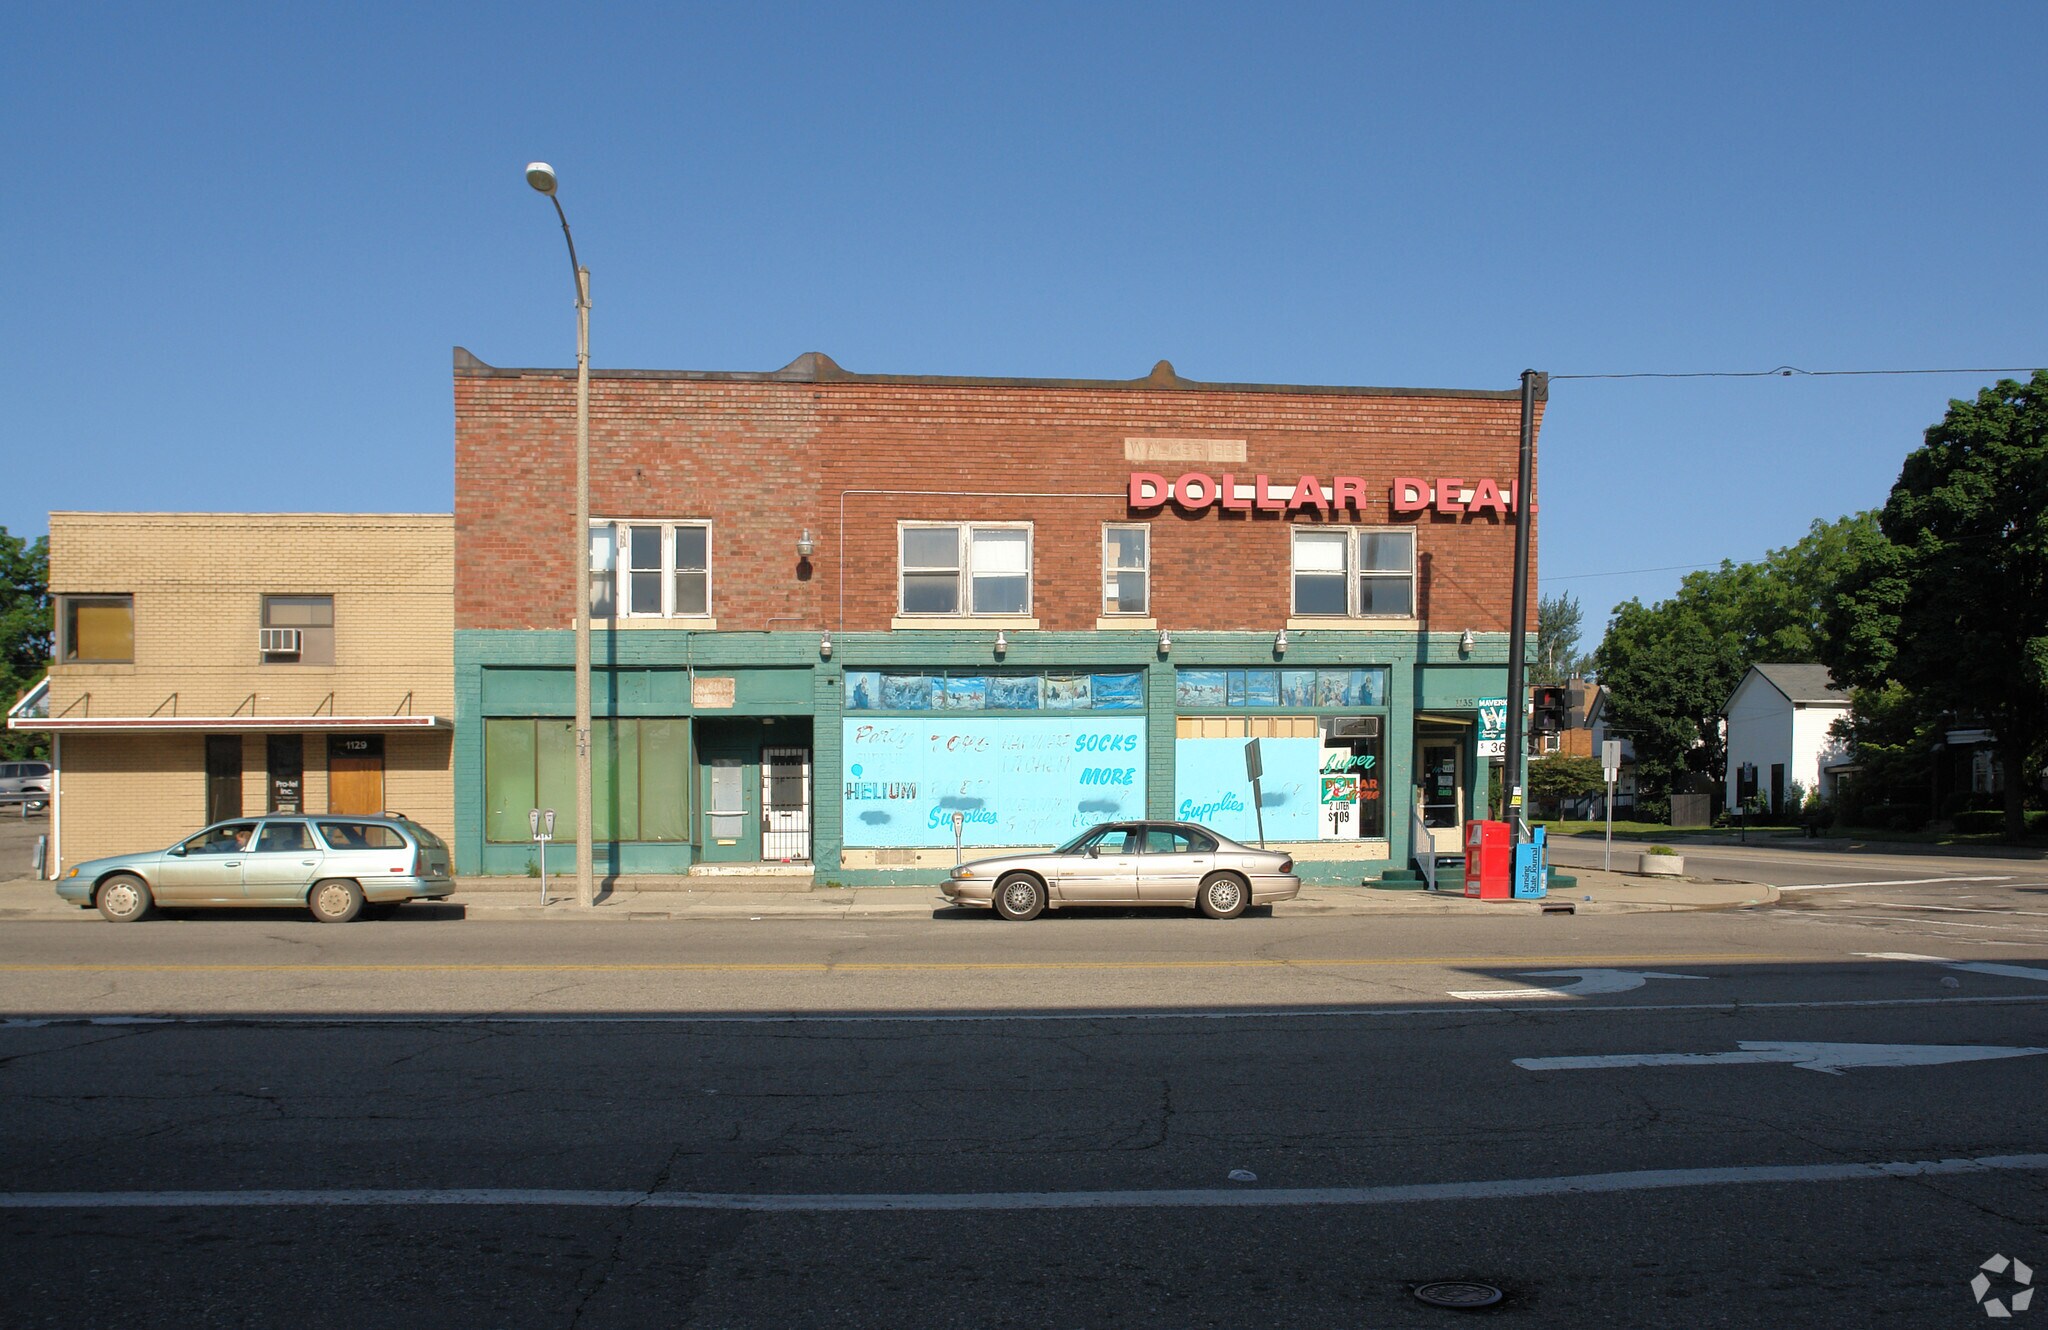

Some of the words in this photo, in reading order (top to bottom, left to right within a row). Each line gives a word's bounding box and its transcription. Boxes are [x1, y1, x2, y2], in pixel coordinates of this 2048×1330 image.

[1130, 441, 1203, 457] WALKER
[1130, 473, 1368, 510] DOLLAR
[346, 741, 367, 750] 1129
[1074, 734, 1137, 752] SOCKS
[1323, 754, 1376, 775] Super
[1080, 767, 1136, 785] MORE
[845, 782, 917, 800] HELIUM
[1178, 792, 1244, 822] Supplies
[1329, 802, 1333, 811] 2
[1336, 802, 1350, 811] LITER
[1530, 847, 1538, 873] Journal
[1522, 866, 1532, 893] Lansing
[1530, 872, 1538, 893] State
